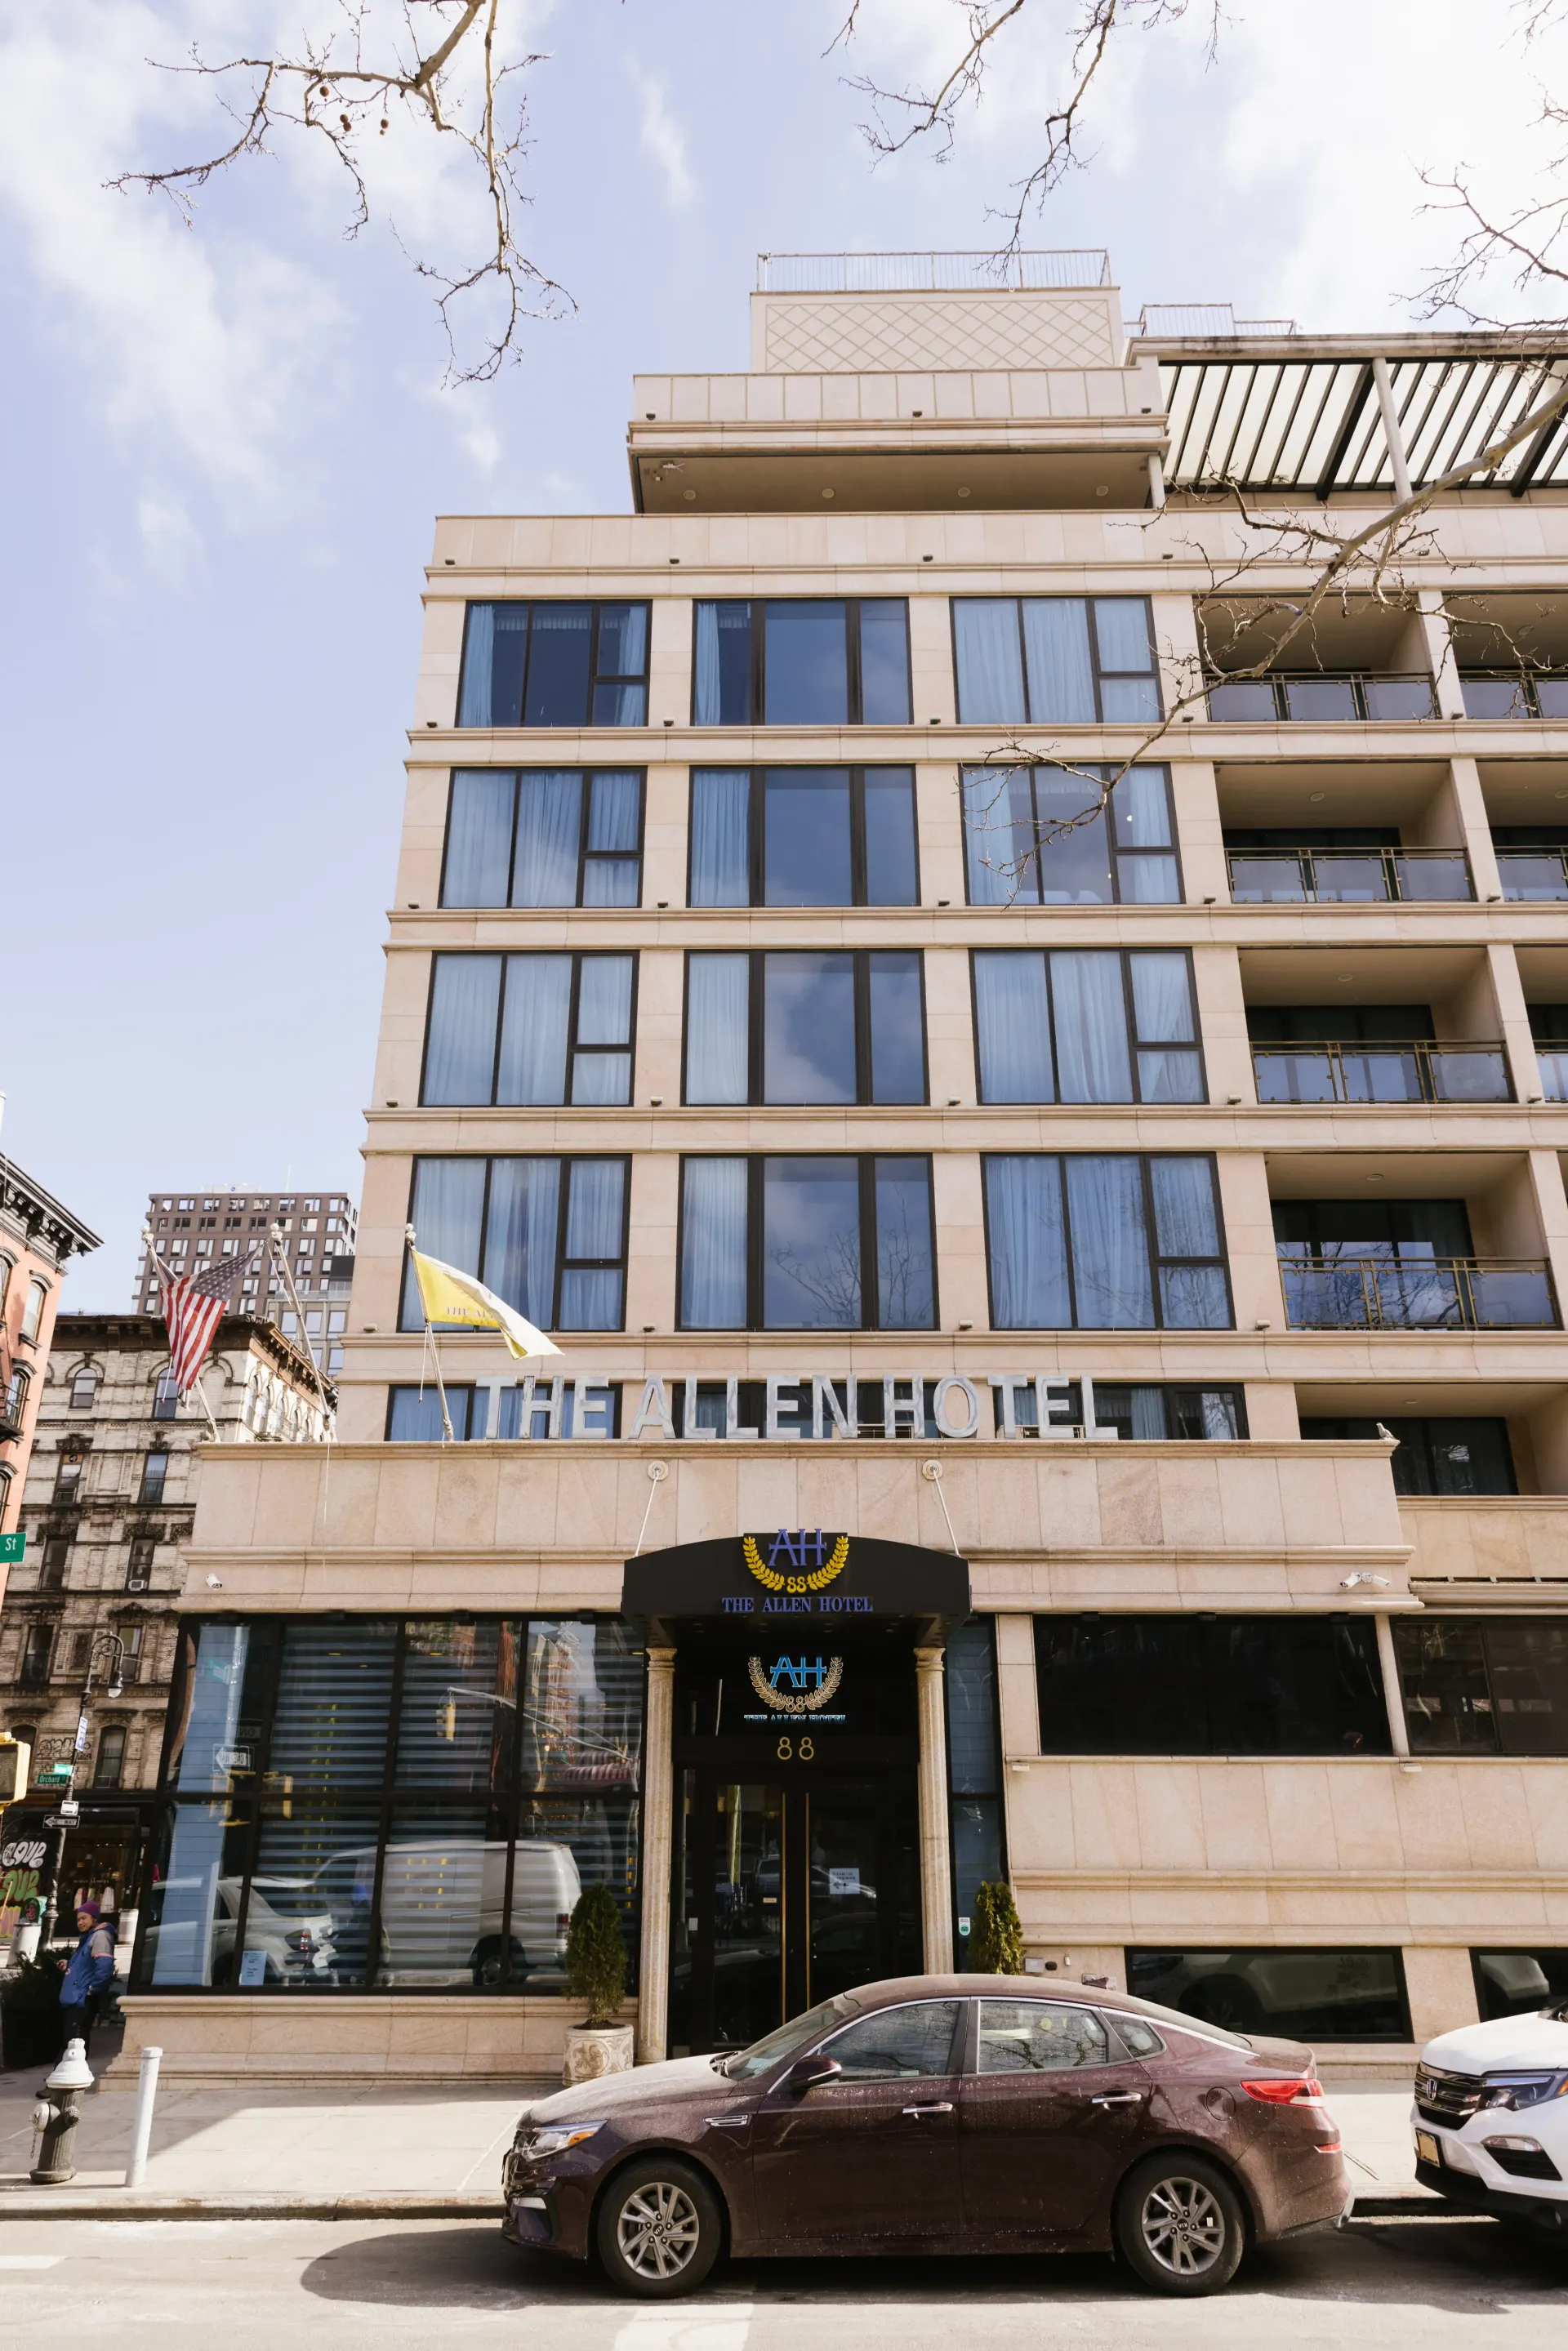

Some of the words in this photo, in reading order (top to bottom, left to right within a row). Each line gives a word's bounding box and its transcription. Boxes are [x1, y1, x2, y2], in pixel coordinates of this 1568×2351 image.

[476, 1375, 608, 1440] THE
[628, 1375, 858, 1440] ALLEN
[883, 1374, 1119, 1440] HOTEL
[5, 1537, 17, 1551] St
[767, 1529, 826, 1566] AH
[786, 1576, 807, 1592] 88
[722, 1596, 754, 1613] THE
[762, 1596, 812, 1613] ALLEN
[819, 1596, 873, 1613] HOTEL
[769, 1655, 826, 1688] AH
[785, 1695, 805, 1712] 88
[777, 1736, 815, 1761] 88
